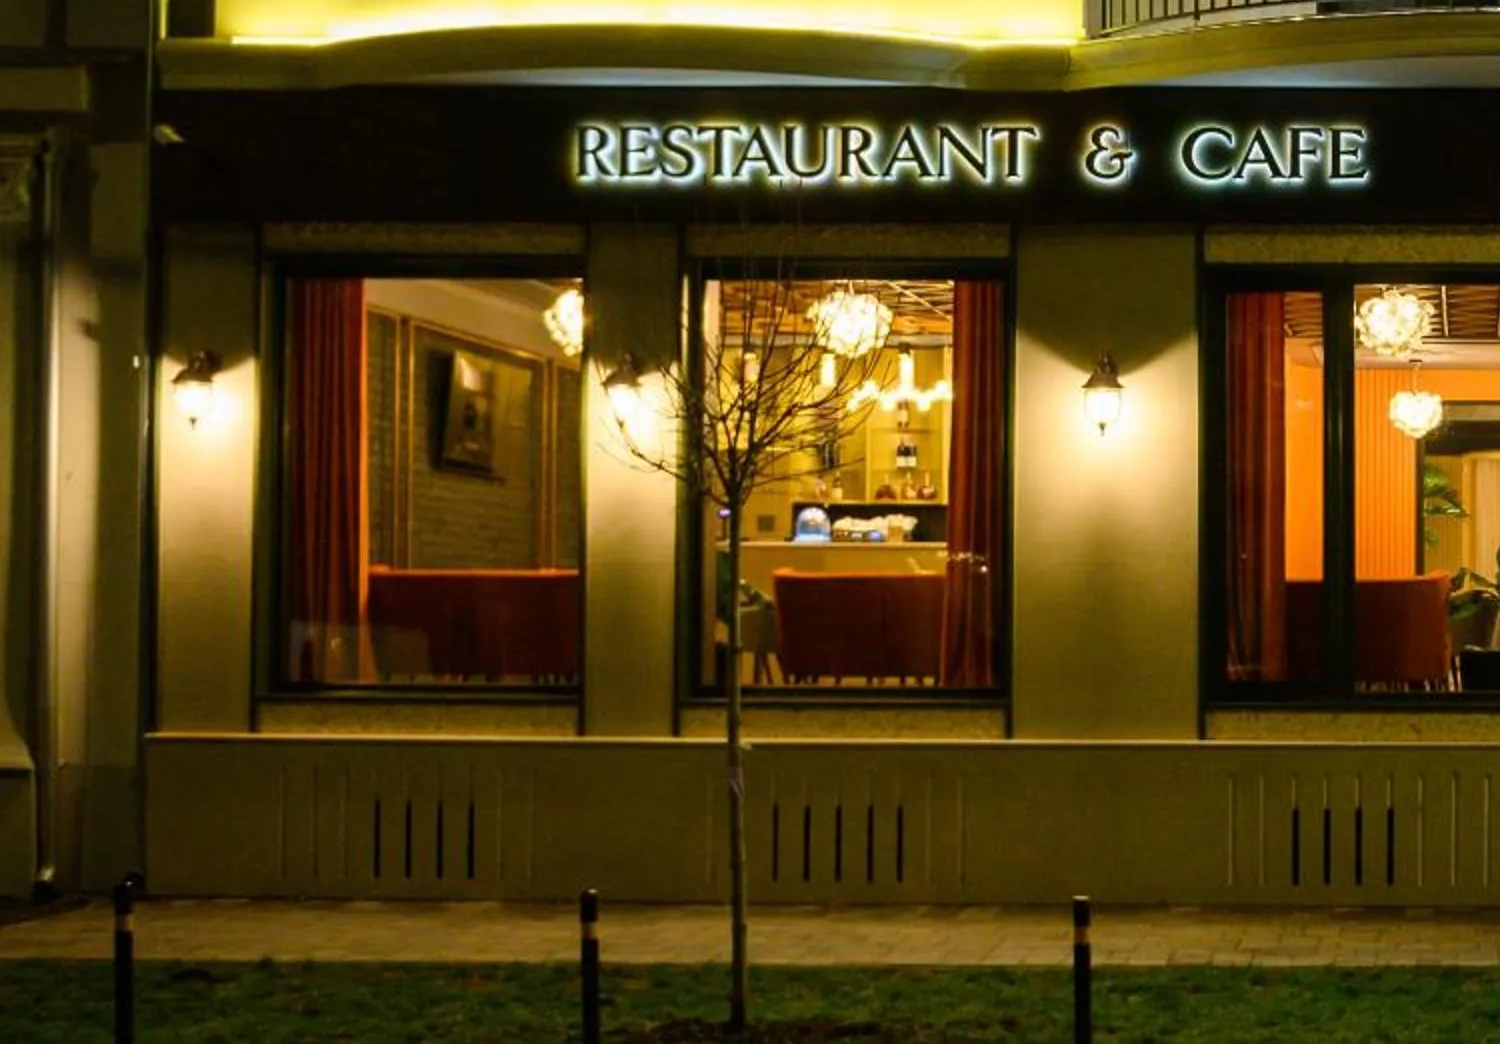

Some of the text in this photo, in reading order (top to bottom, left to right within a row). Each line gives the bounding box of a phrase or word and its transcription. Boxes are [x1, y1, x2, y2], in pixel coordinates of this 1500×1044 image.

[573, 123, 1371, 182] RESTAURANT & CAFE
